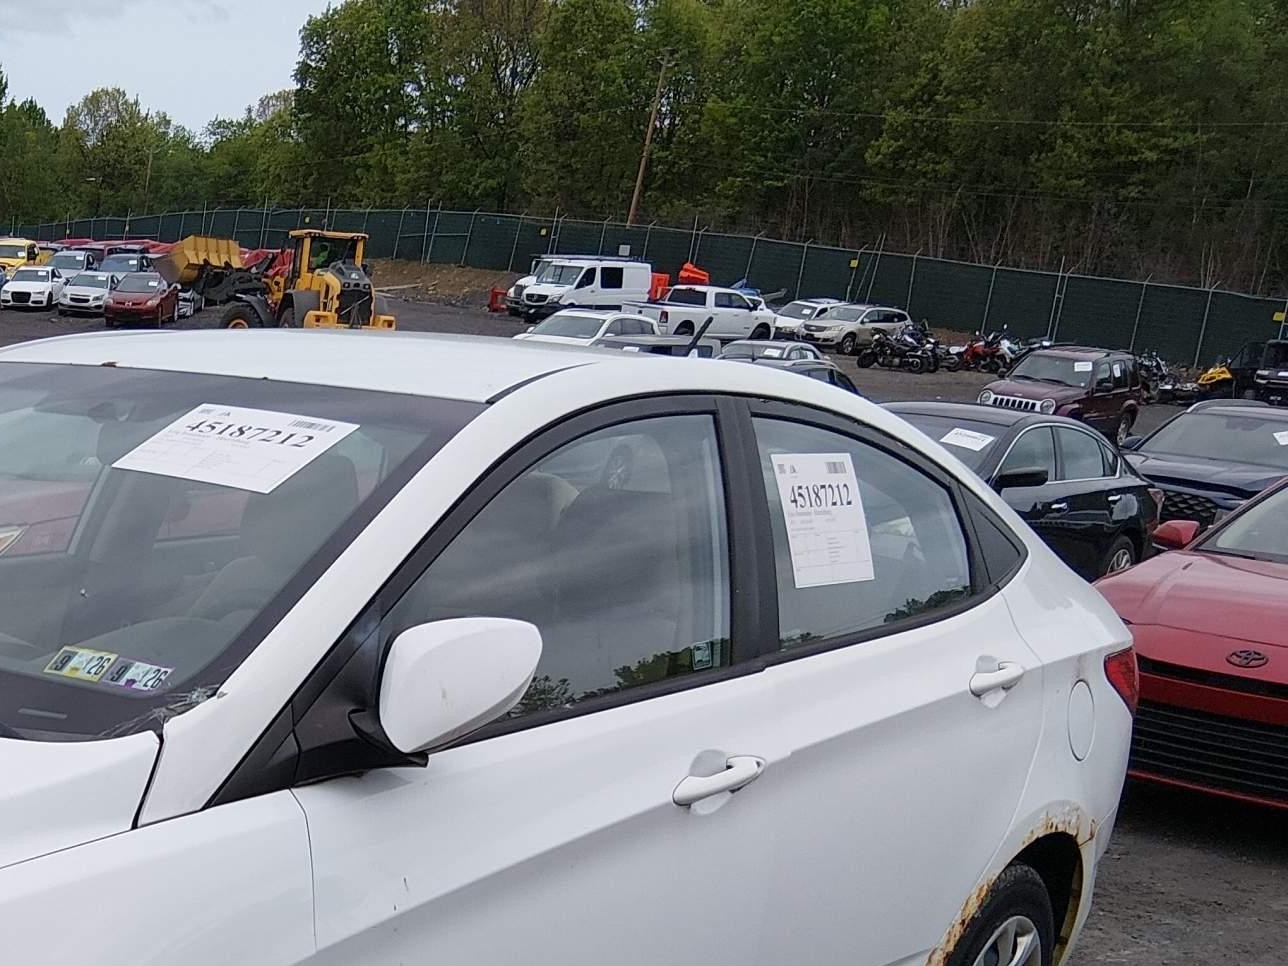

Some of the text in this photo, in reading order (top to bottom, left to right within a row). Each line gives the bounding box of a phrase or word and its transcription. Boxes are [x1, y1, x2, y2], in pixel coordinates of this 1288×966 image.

[187, 420, 314, 448] 45187212
[790, 483, 852, 508] 45187212
[87, 656, 111, 675] 26
[143, 669, 168, 688] 26
